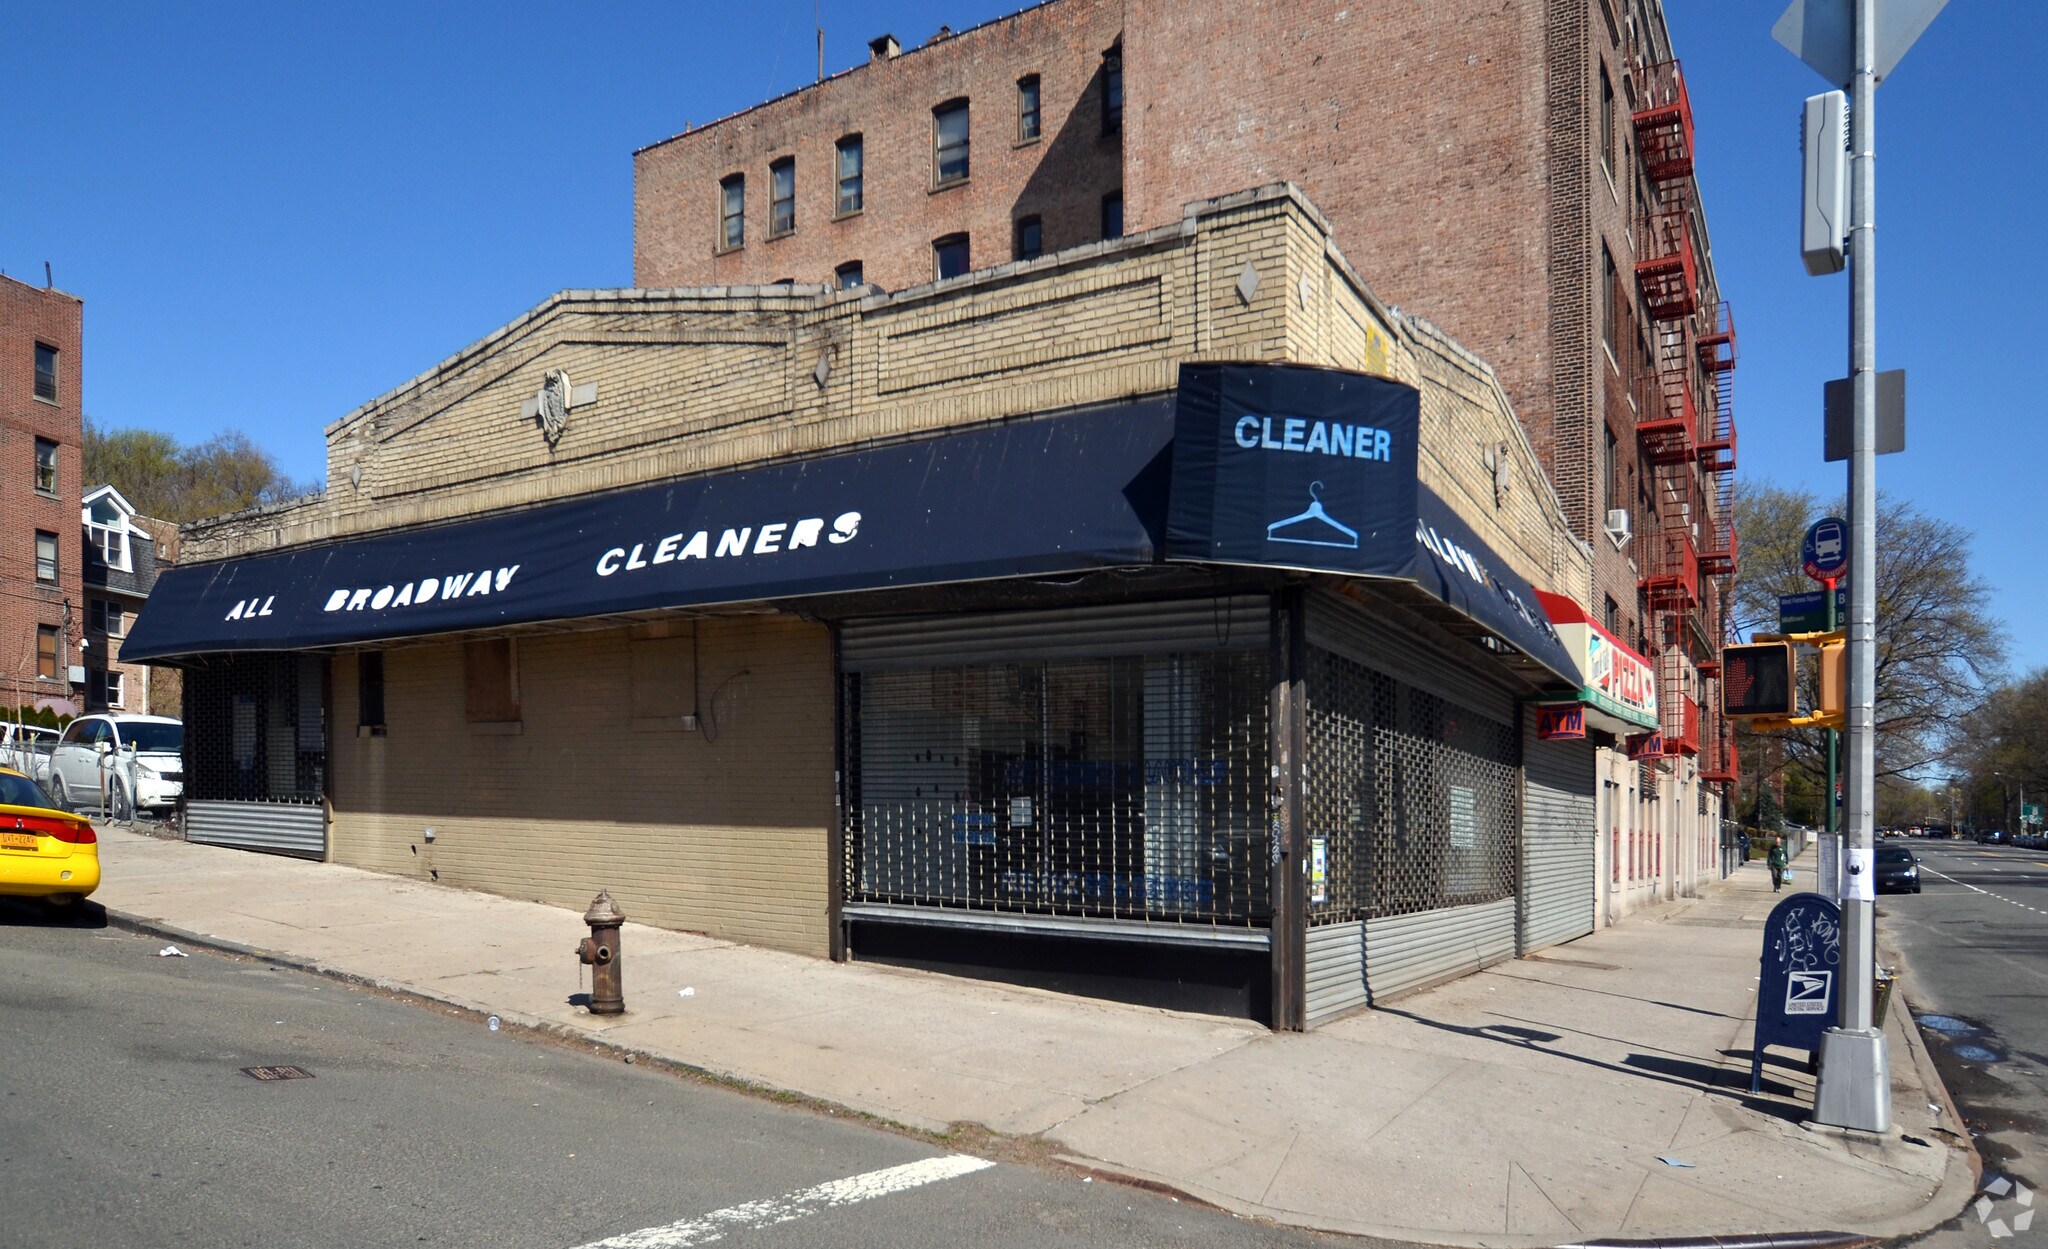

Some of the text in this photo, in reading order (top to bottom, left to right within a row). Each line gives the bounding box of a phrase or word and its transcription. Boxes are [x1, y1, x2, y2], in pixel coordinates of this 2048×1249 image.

[1235, 416, 1390, 461] CLEANER
[225, 512, 861, 621] ALL BROADWAY CLEANERS
[1806, 562, 1847, 578] NO STANDIN
[1611, 648, 1645, 709] PIZZA
[1539, 710, 1583, 732] ATM
[1630, 736, 1662, 754] ATM
